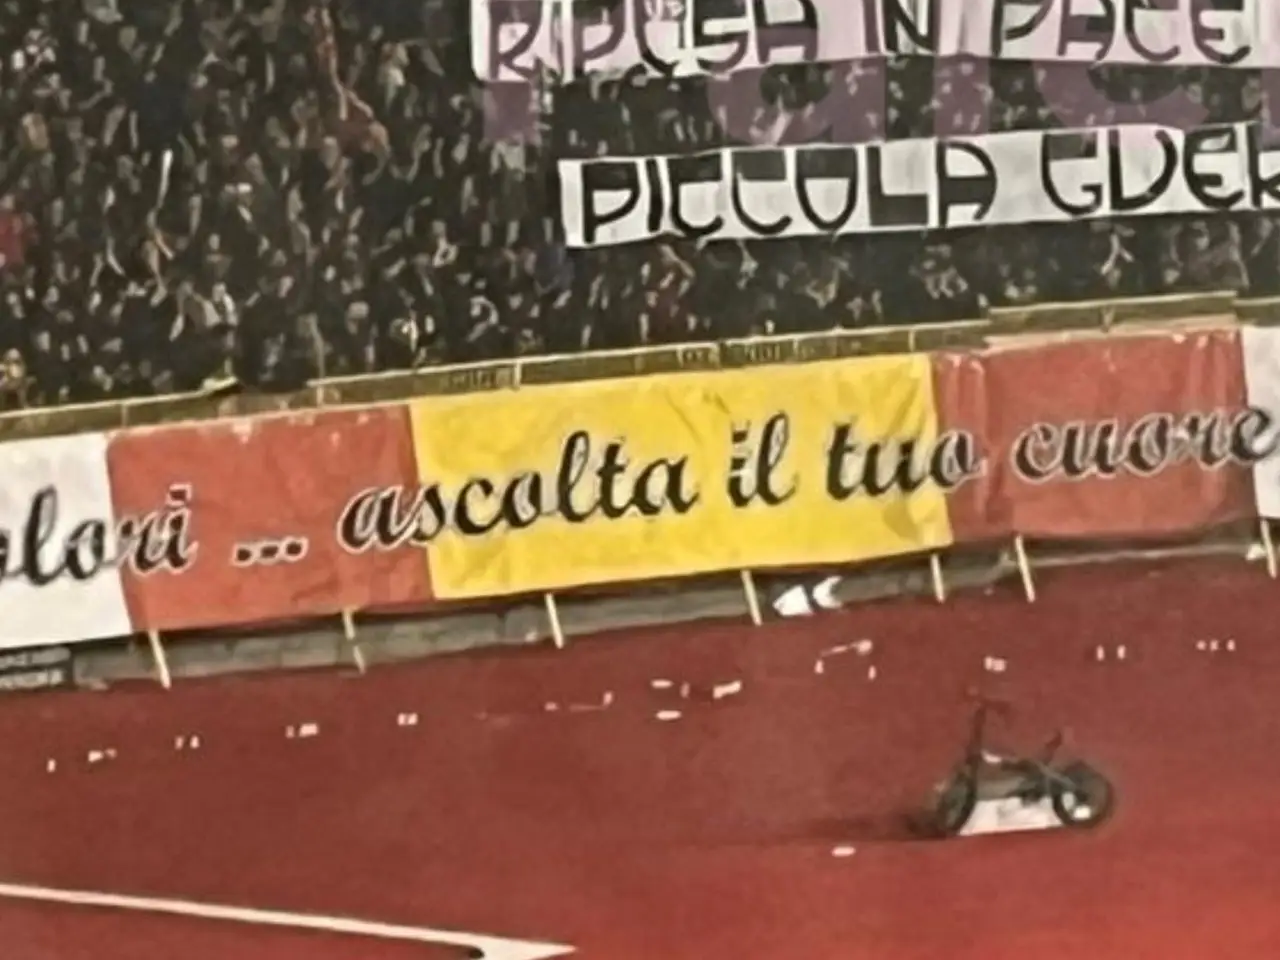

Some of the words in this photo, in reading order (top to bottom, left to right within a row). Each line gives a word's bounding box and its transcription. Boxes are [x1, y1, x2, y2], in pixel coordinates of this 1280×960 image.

[580, 141, 998, 243] PICCOLA
[338, 428, 698, 552] ascolta
[728, 410, 795, 508] il
[824, 418, 985, 496] tuo
